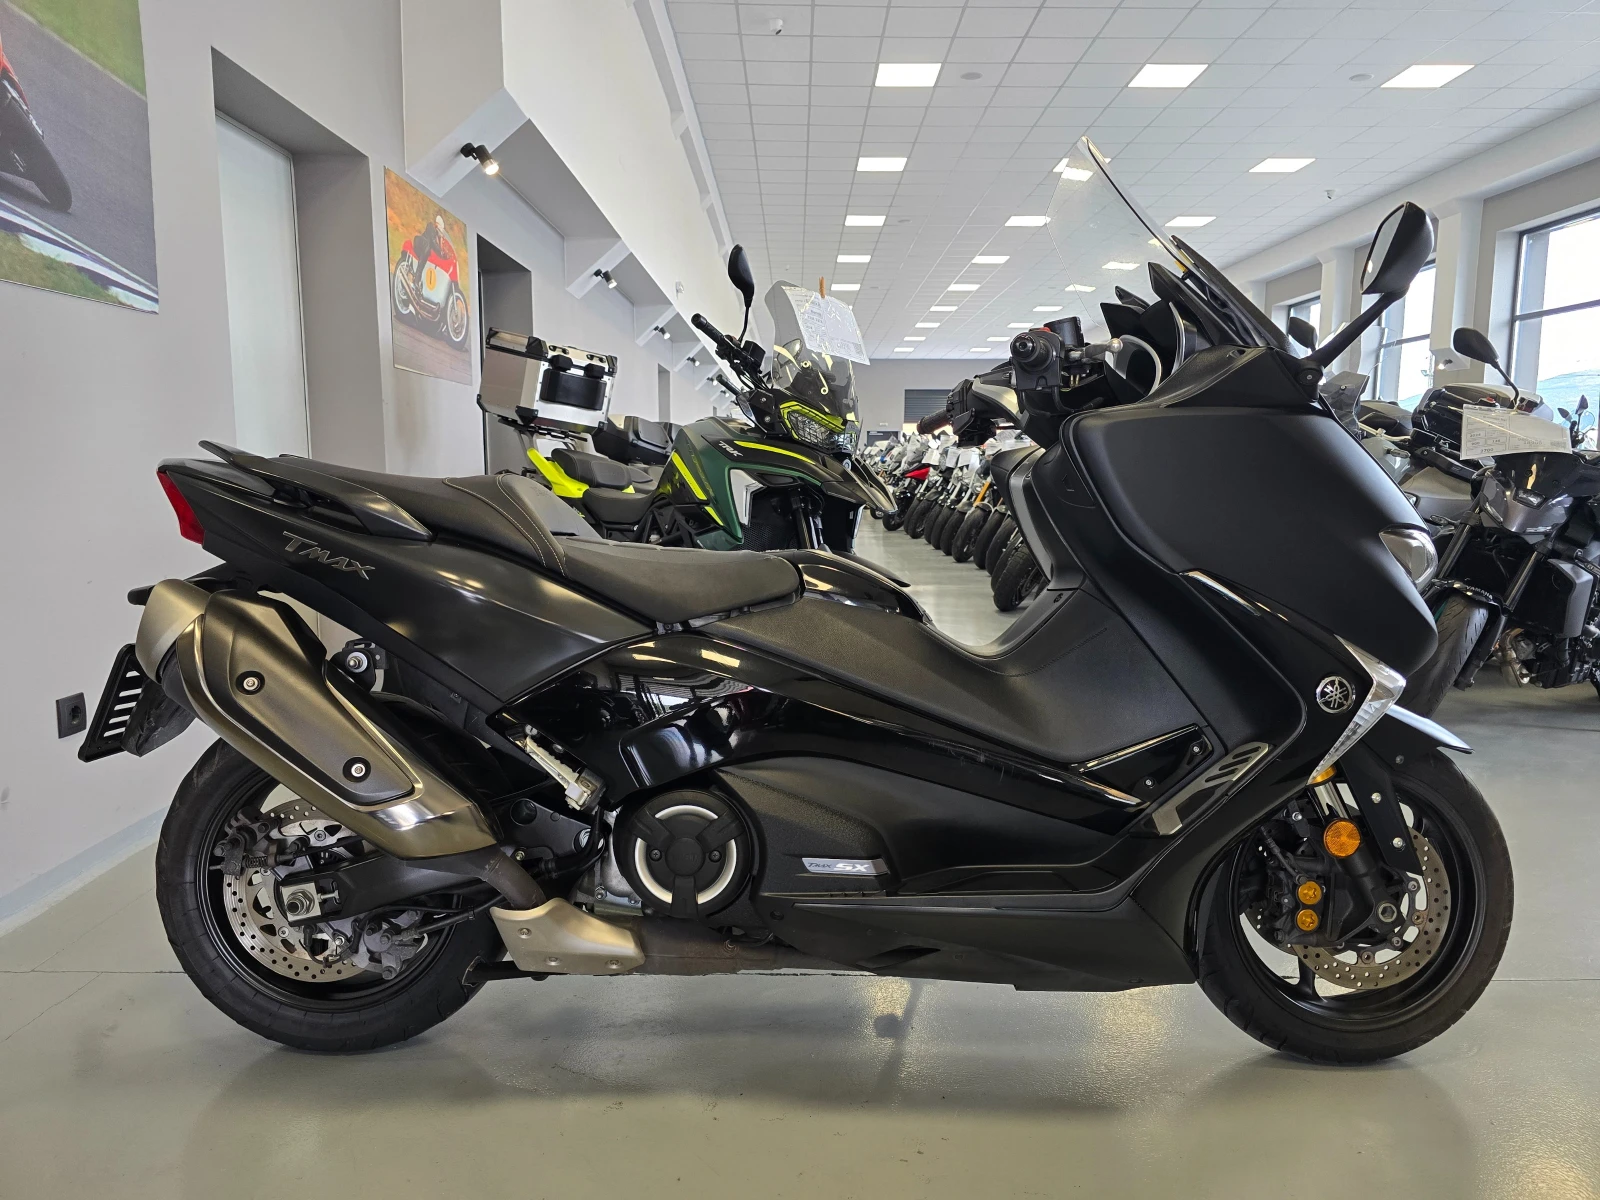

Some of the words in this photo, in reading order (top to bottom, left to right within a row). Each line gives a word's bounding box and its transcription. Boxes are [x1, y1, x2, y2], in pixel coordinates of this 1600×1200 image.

[718, 440, 744, 457] TRK
[282, 531, 376, 580] TMAX
[1466, 585, 1493, 600] YAMAHA
[833, 862, 870, 872] SX
